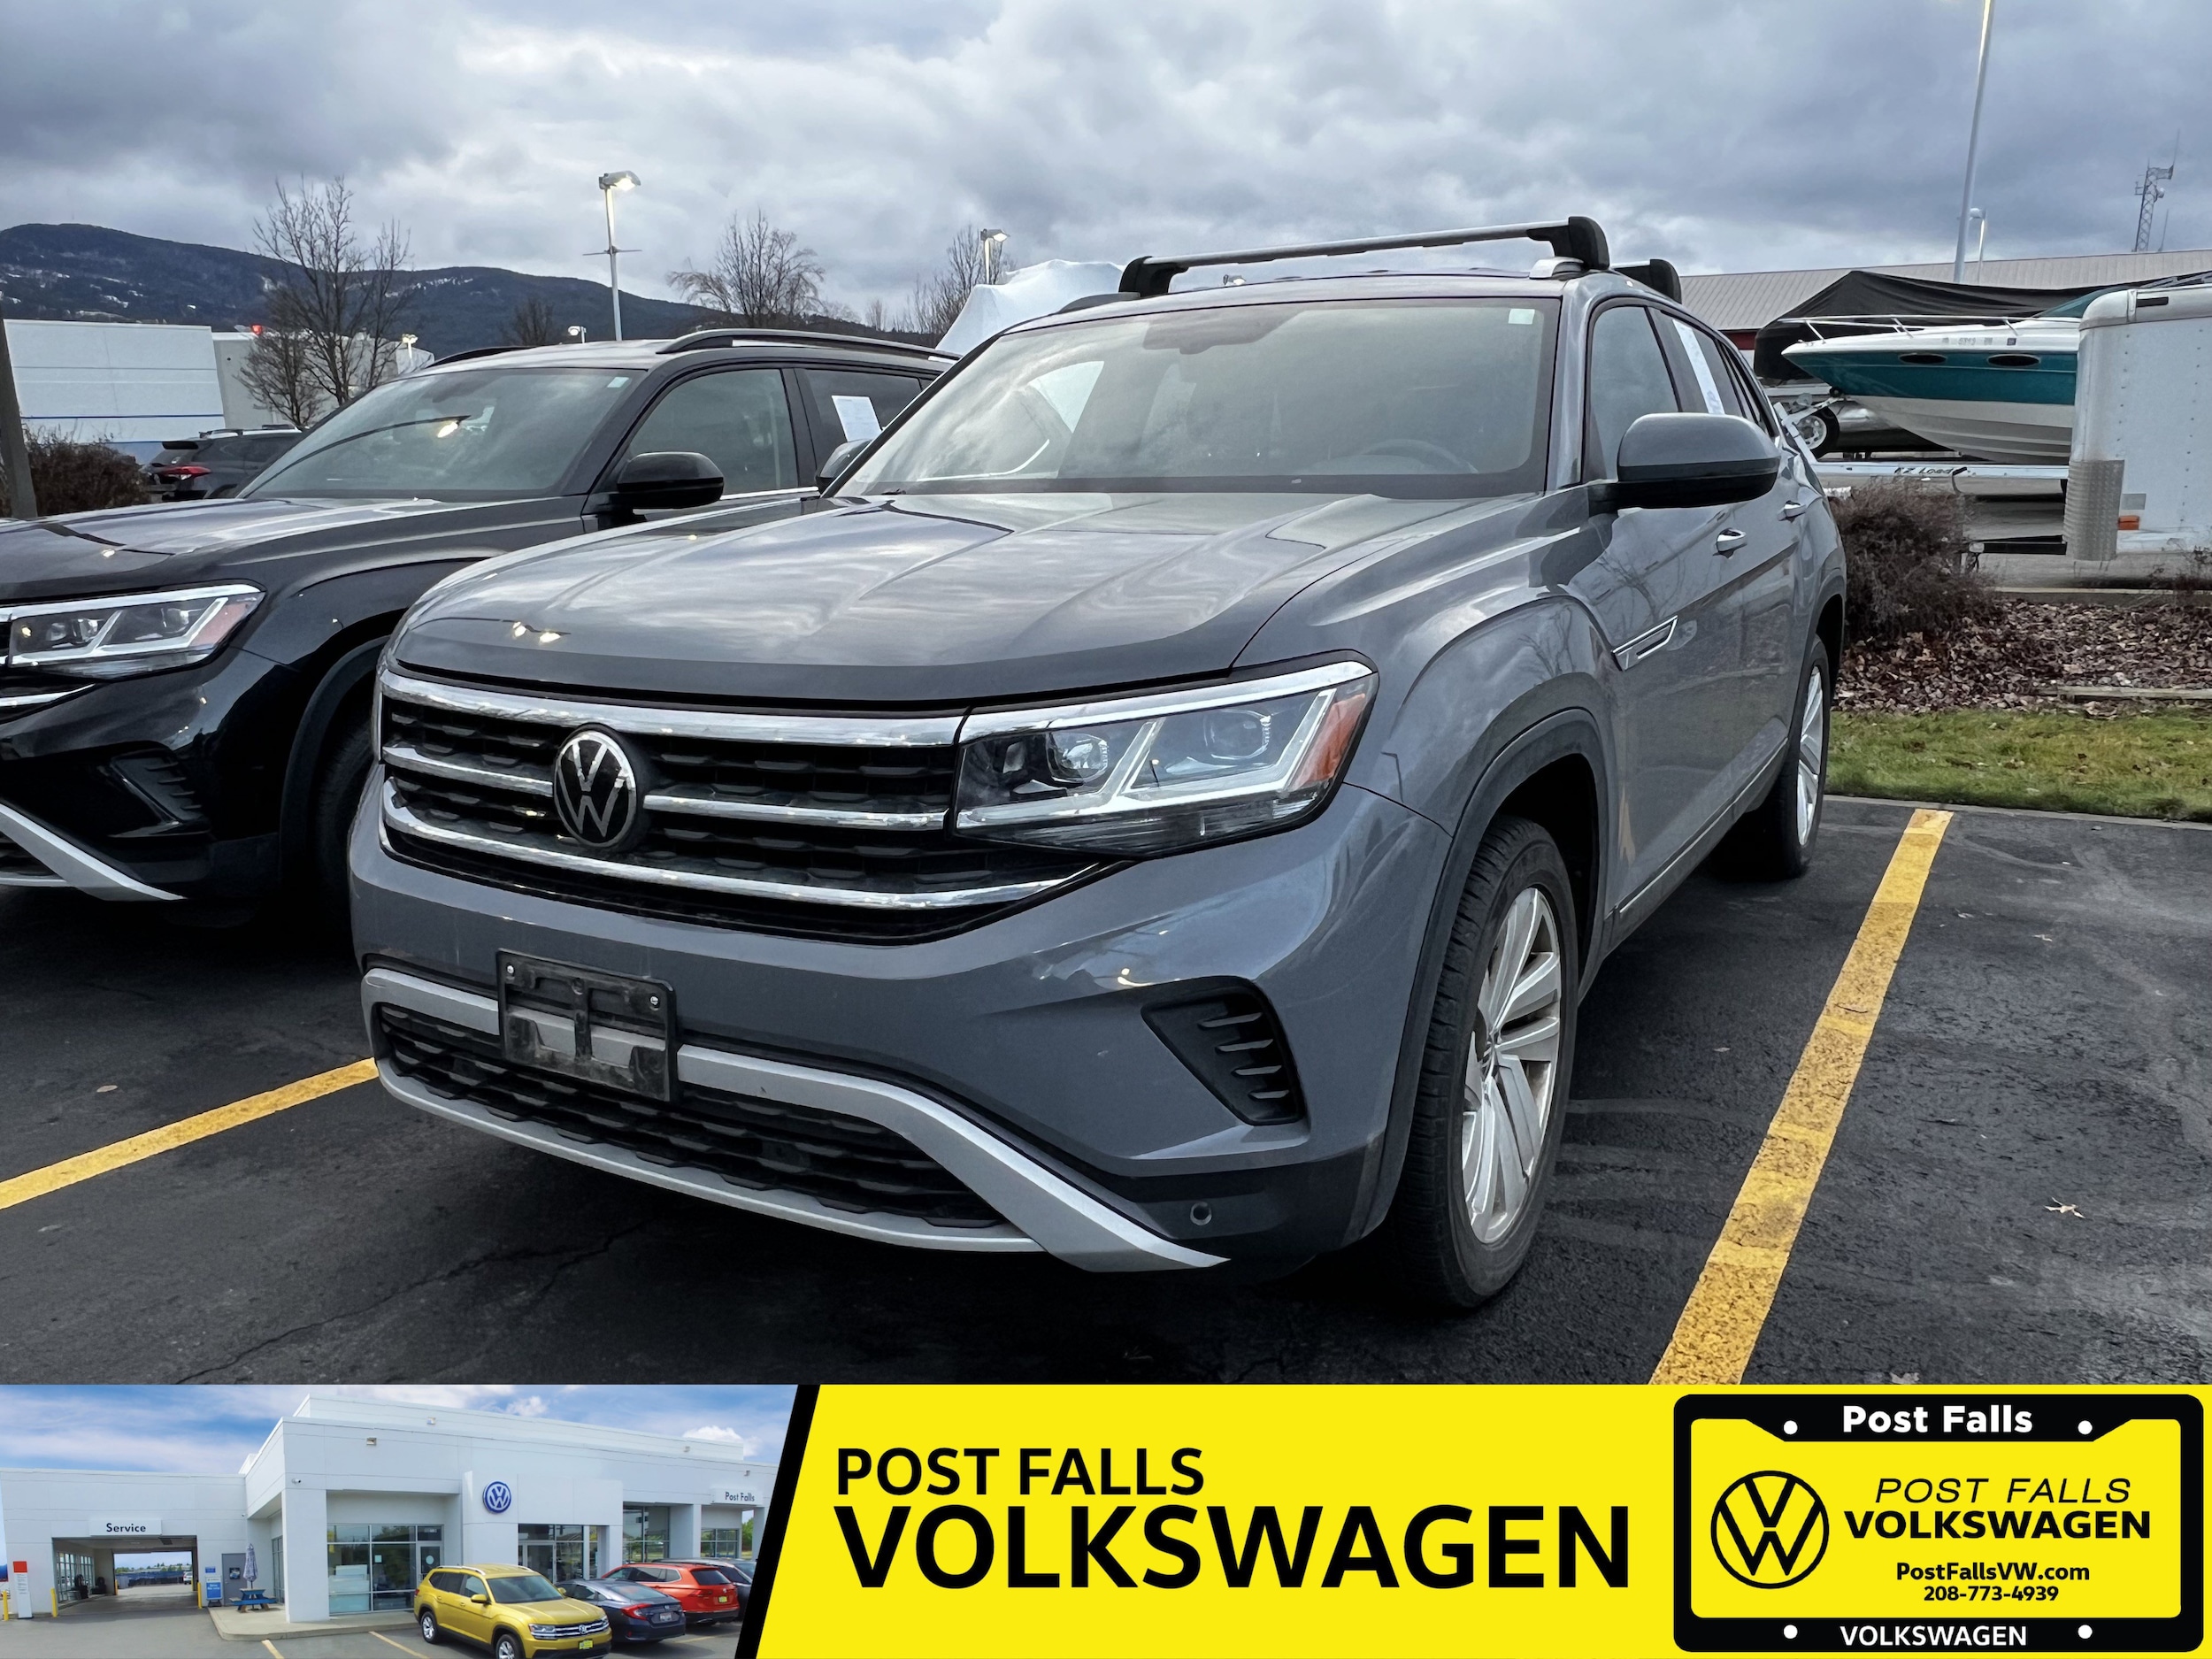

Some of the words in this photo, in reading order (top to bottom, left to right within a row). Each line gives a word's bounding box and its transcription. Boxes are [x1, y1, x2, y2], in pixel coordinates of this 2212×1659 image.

[725, 1491, 739, 1502] Post
[740, 1492, 756, 1502] Falls
[105, 1522, 147, 1533] Service
